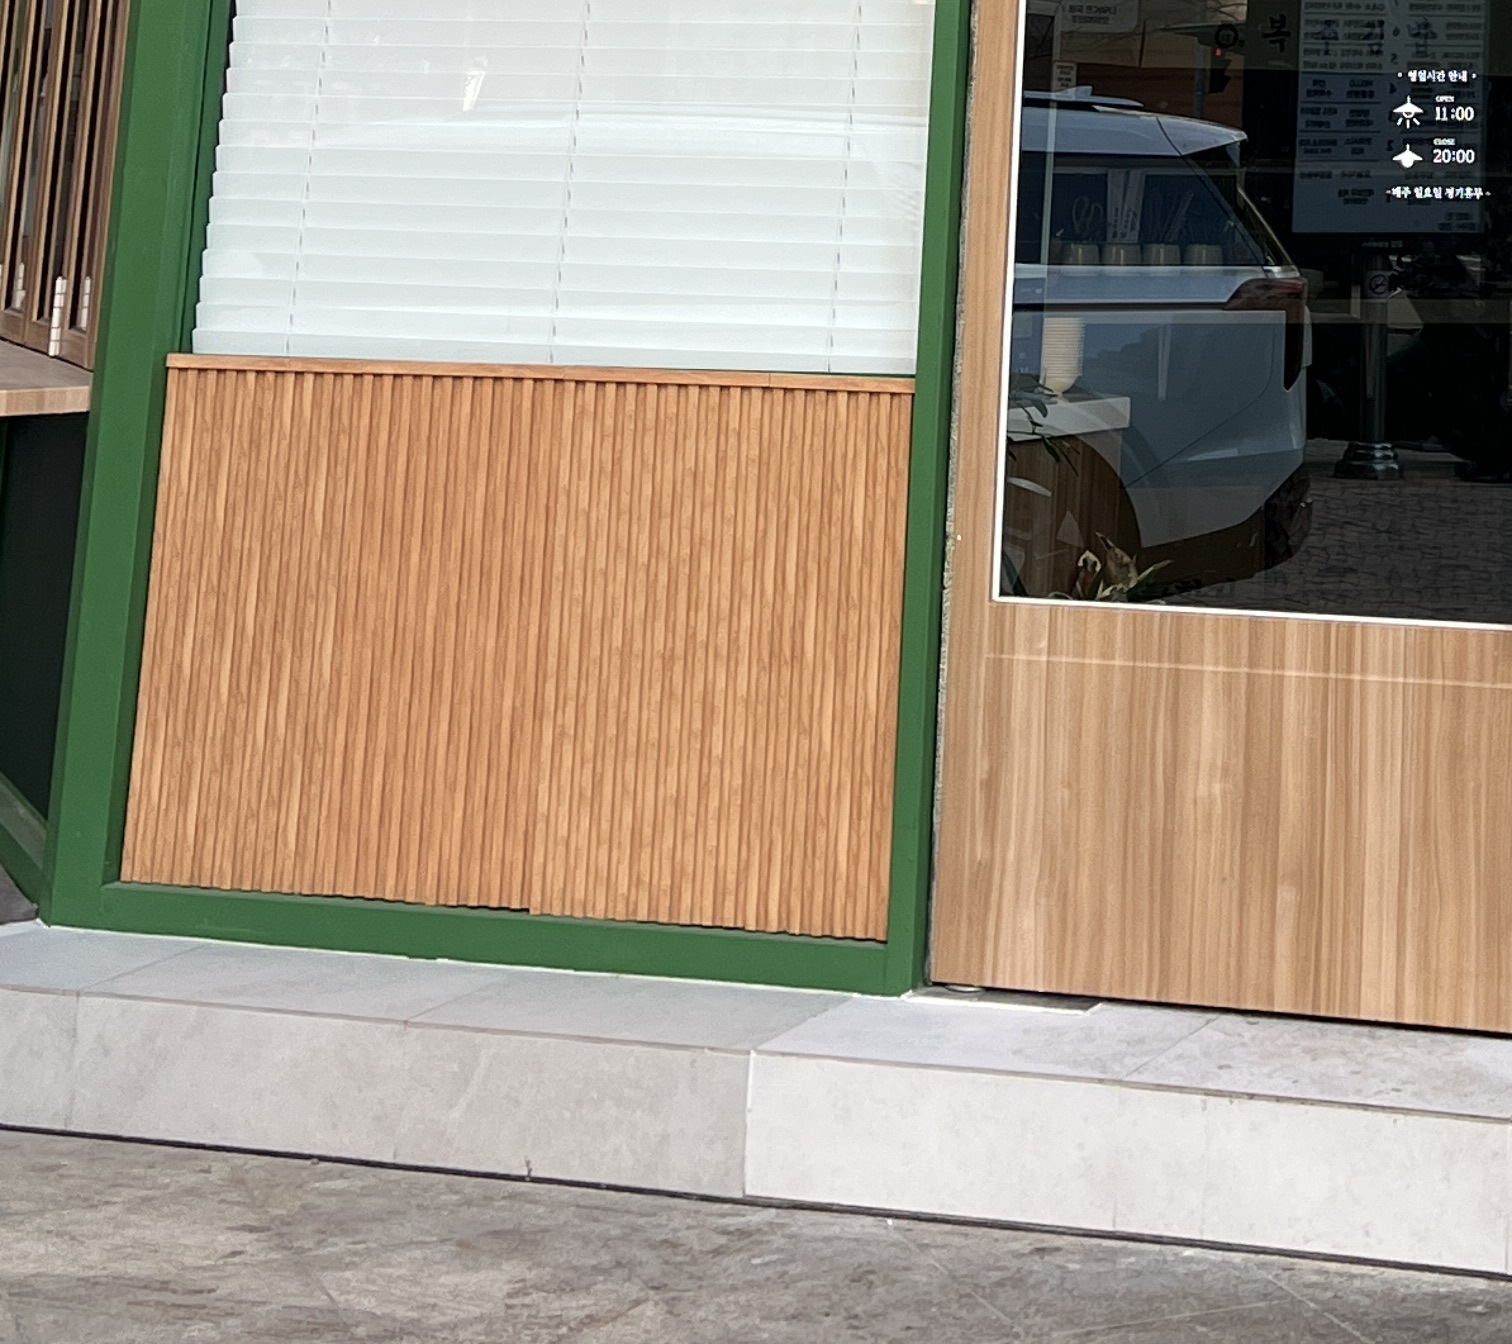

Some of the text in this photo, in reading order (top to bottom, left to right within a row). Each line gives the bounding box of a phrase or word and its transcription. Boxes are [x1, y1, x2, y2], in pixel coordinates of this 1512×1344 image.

[1407, 70, 1468, 83] 영업시간 안내
[1435, 106, 1475, 121] 11:00
[1433, 149, 1475, 163] 20:00
[1413, 187, 1443, 199] 일요일
[1444, 187, 1484, 200] 정기휴무
